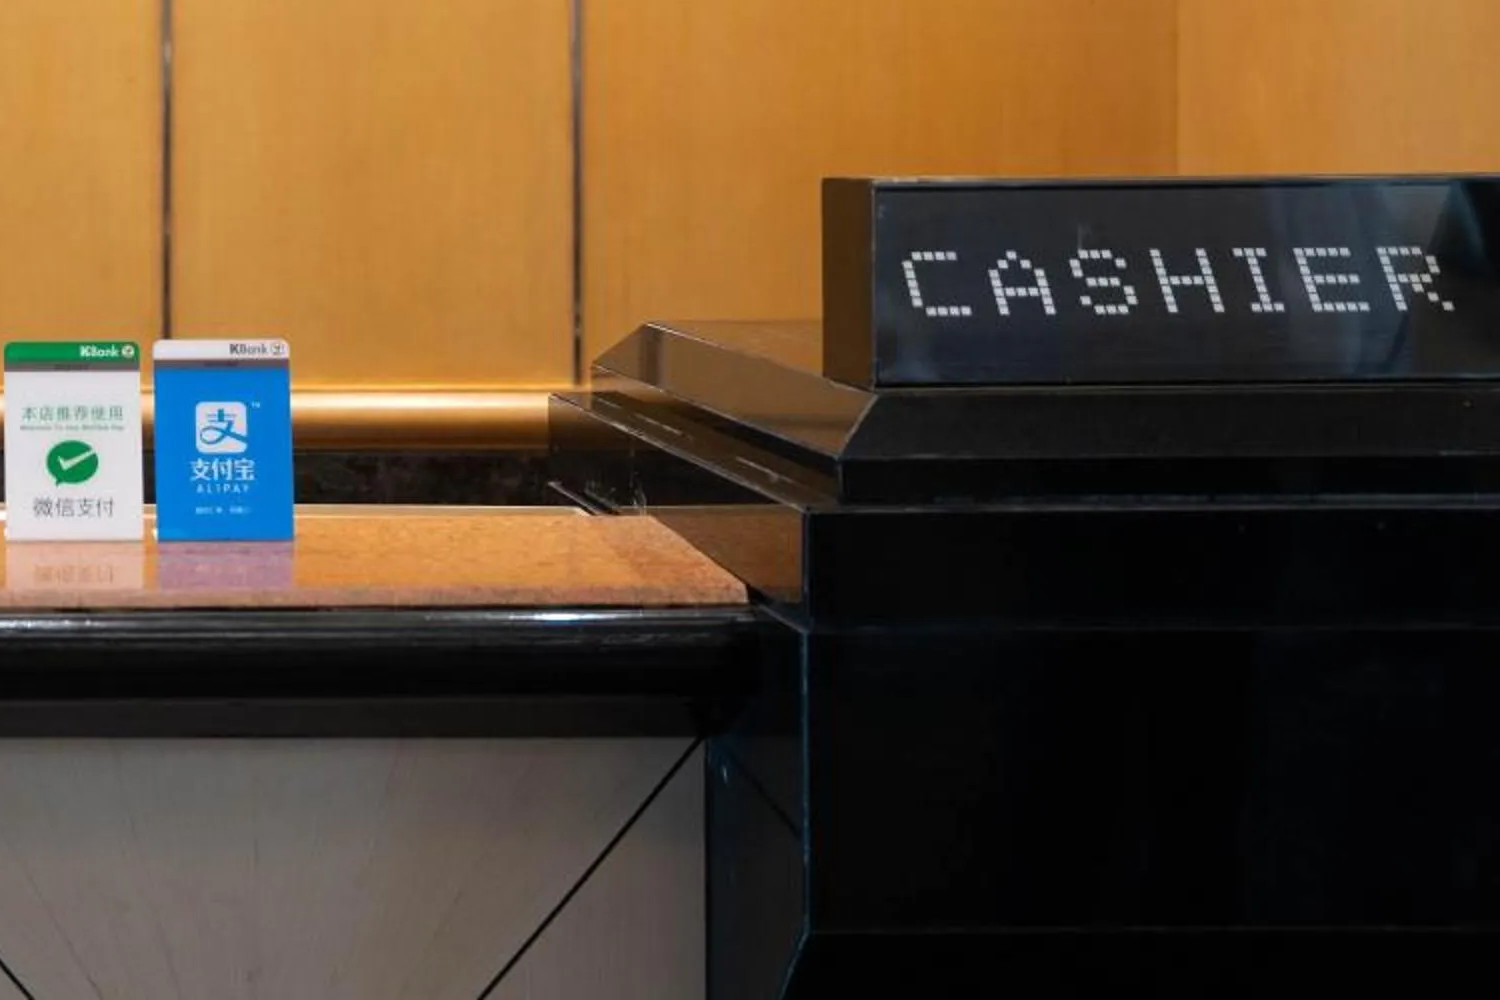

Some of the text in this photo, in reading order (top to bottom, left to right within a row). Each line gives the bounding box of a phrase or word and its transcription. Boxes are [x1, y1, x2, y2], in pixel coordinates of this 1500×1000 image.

[902, 245, 1455, 317] CASHIER
[190, 458, 256, 481] 支付宝
[196, 483, 250, 495] ALIPAY
[33, 498, 115, 518] 微信支付
